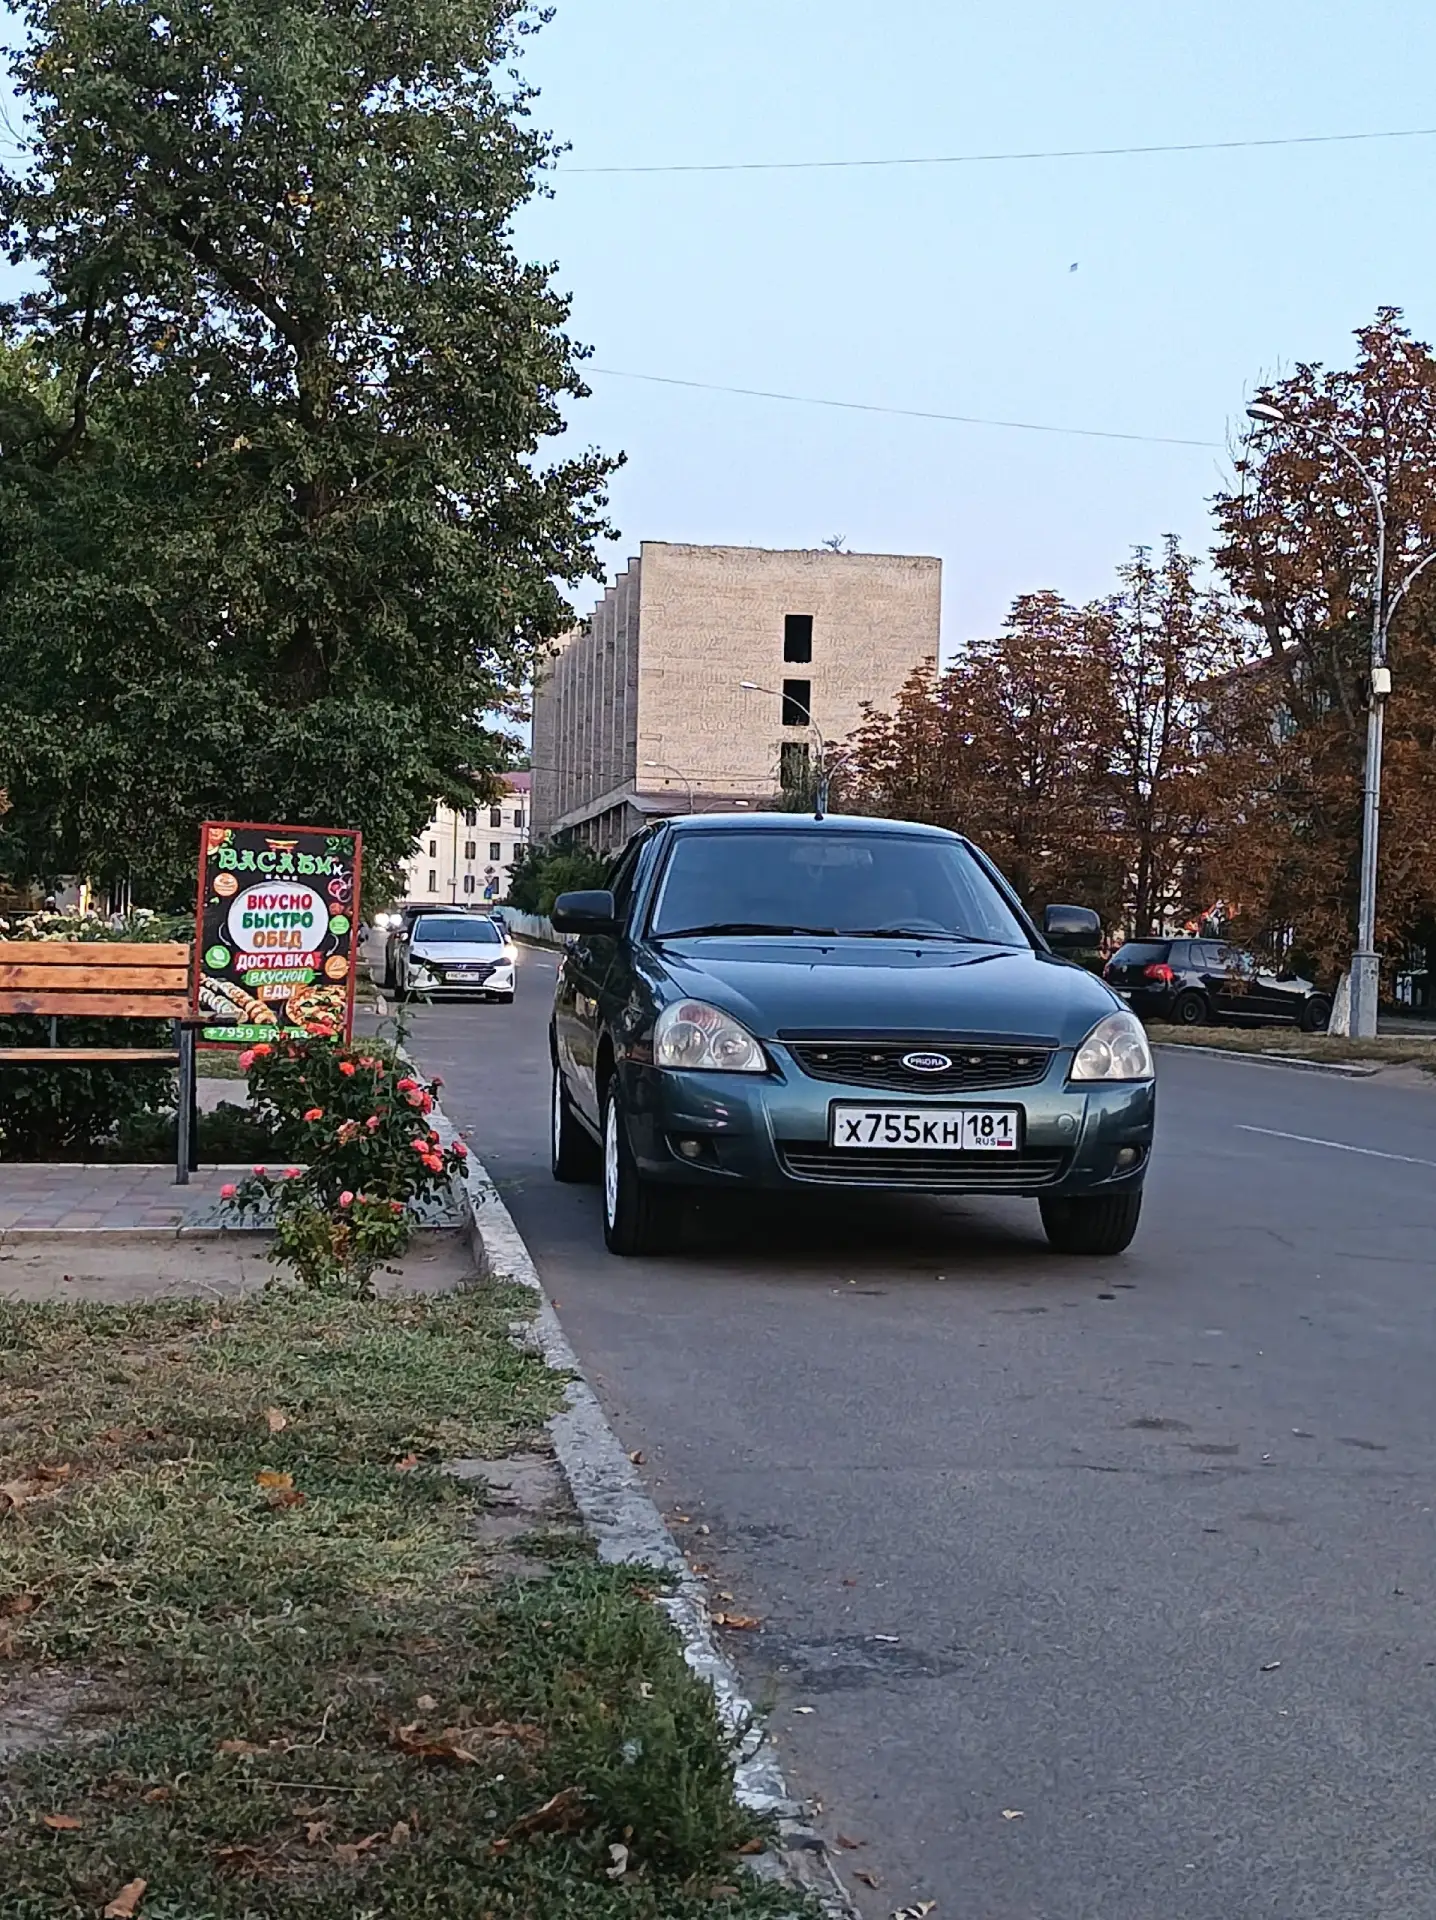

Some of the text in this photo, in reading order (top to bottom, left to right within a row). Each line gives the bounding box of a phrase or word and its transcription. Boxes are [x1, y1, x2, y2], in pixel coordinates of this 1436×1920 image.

[247, 894, 313, 911] ВКУСНО
[242, 911, 314, 929] БЫСТРО
[252, 930, 302, 950] ОБЕД
[236, 953, 315, 971] ДОСТАВКА
[263, 984, 296, 999] ЕДЫ
[909, 1057, 945, 1067] PRIORA
[967, 1114, 1009, 1138] 181
[975, 1137, 996, 1146] RUS
